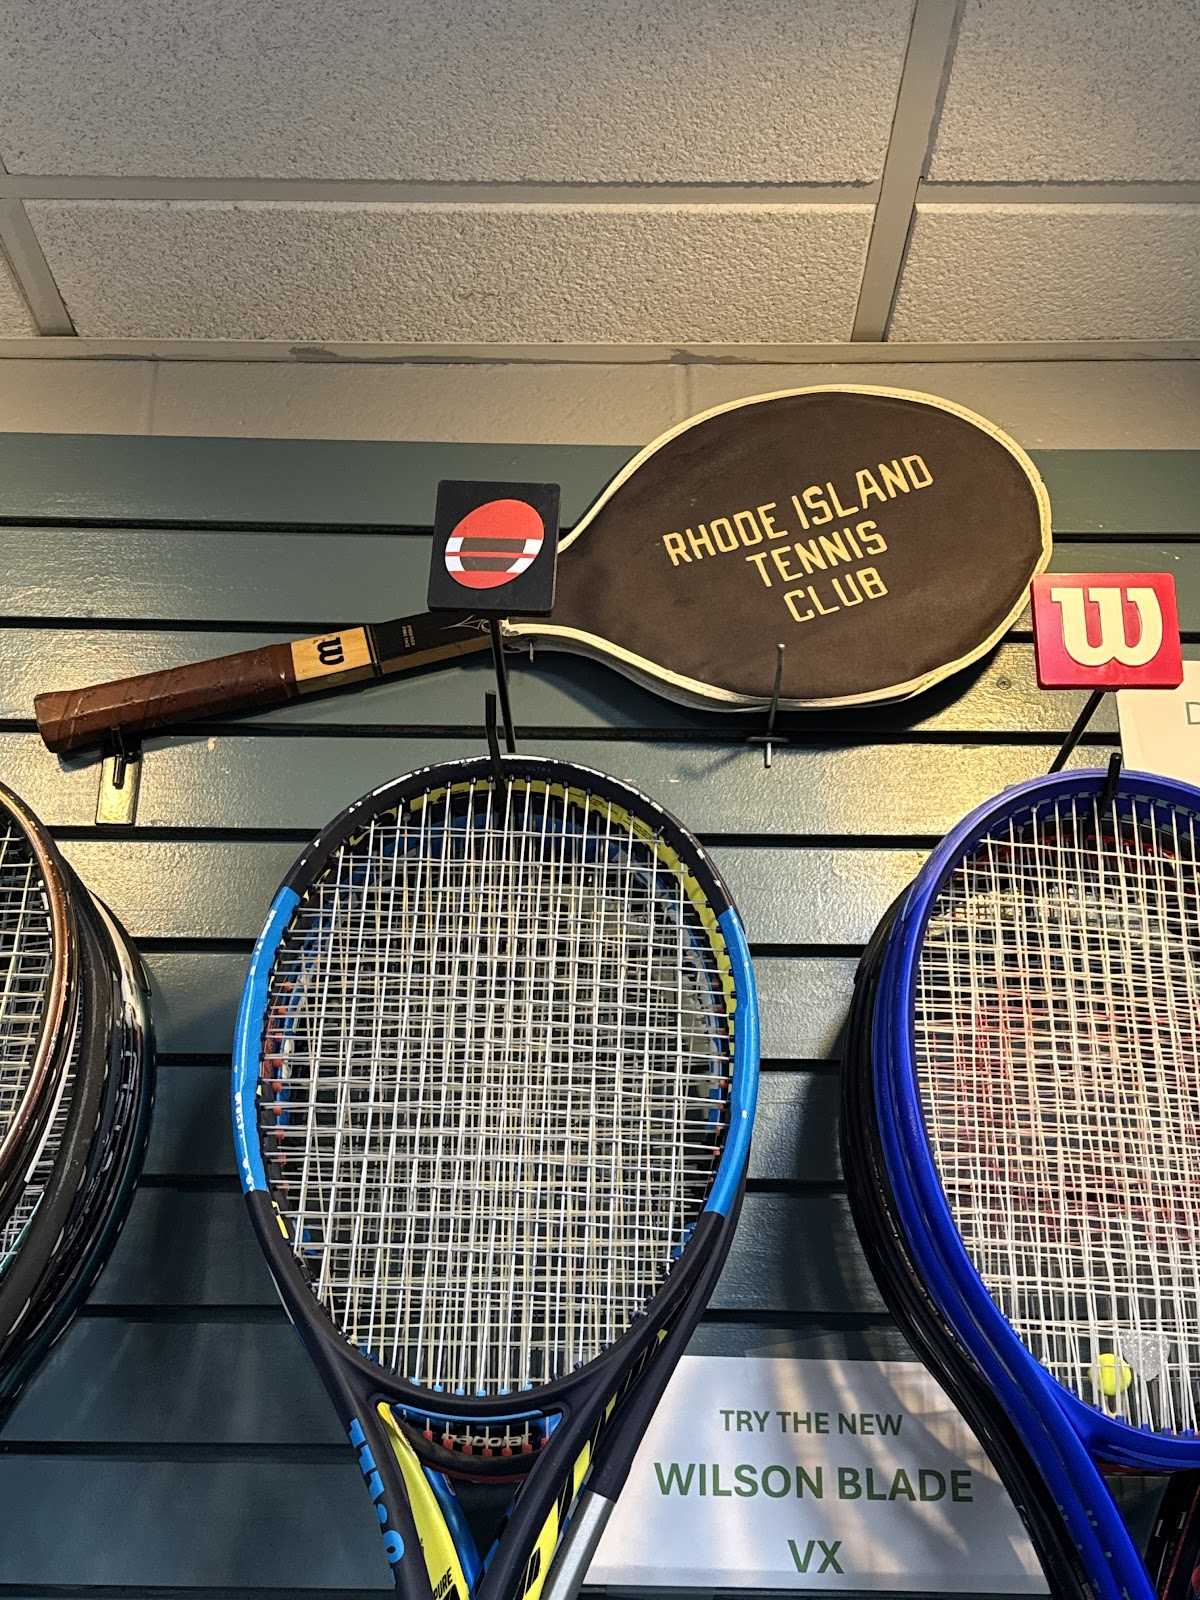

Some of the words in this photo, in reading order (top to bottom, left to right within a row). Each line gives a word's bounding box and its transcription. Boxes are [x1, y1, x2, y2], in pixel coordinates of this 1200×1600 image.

[662, 502, 789, 567] RHODE
[791, 454, 934, 530] ISLAND
[745, 520, 888, 588] TENNIS
[783, 566, 889, 623] CLUB
[1050, 587, 1163, 667] W
[719, 1409, 770, 1432] TRY
[776, 1411, 830, 1434] THE
[837, 1412, 903, 1436] NEW
[654, 1462, 823, 1499] WILSON
[837, 1467, 974, 1503] BLADE
[787, 1539, 846, 1574] VX
